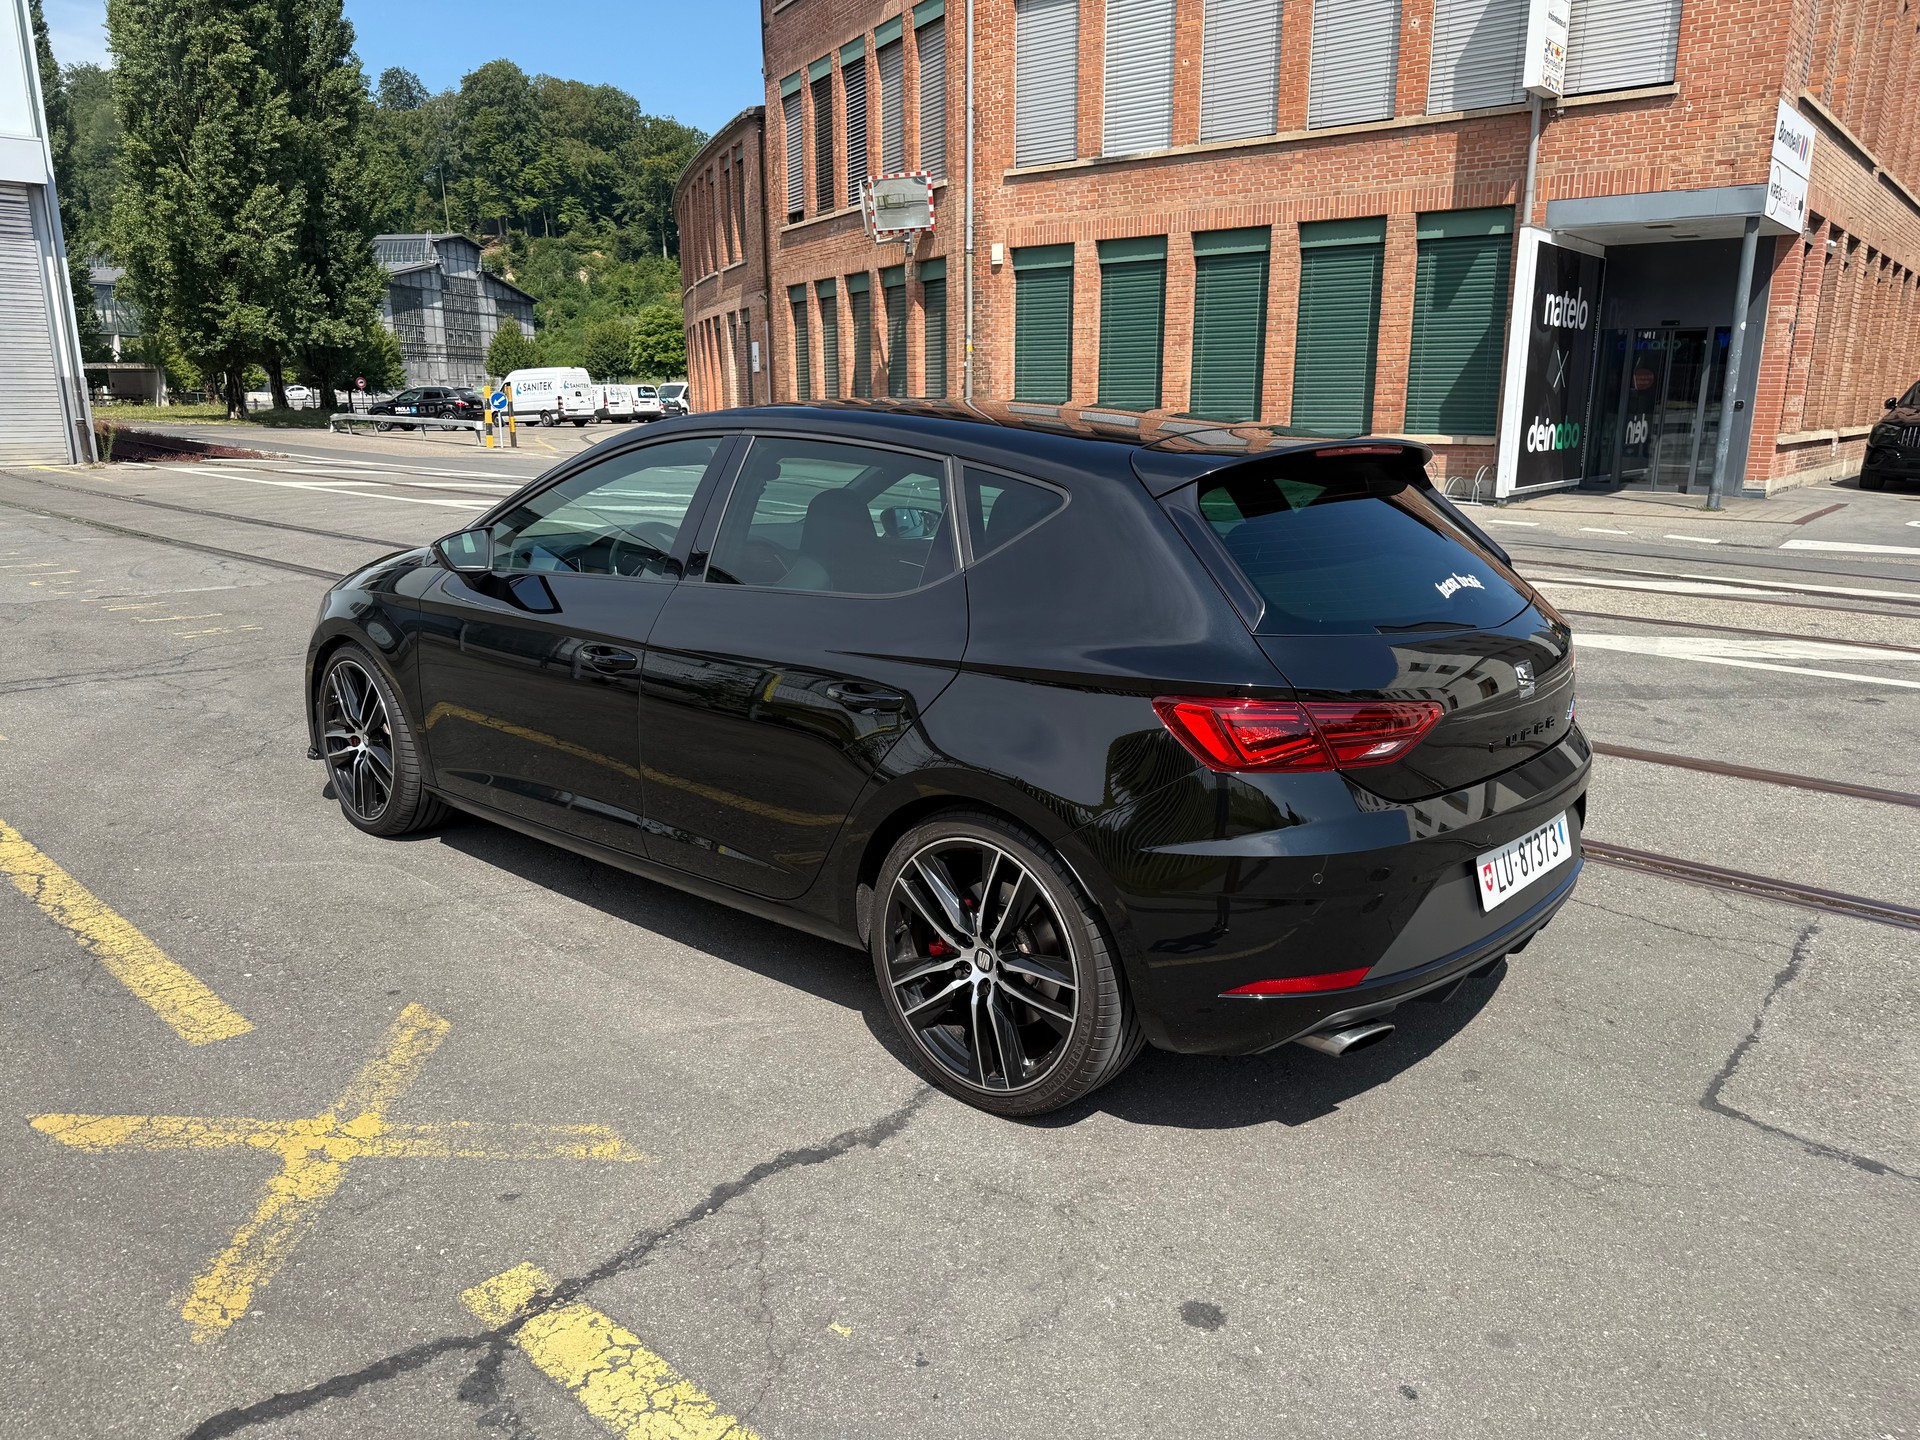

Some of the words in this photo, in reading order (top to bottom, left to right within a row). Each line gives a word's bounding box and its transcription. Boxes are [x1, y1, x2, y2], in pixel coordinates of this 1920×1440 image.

[1544, 287, 1588, 330] natelo
[523, 382, 552, 391] SANITEK
[1527, 415, 1580, 453] deinabo
